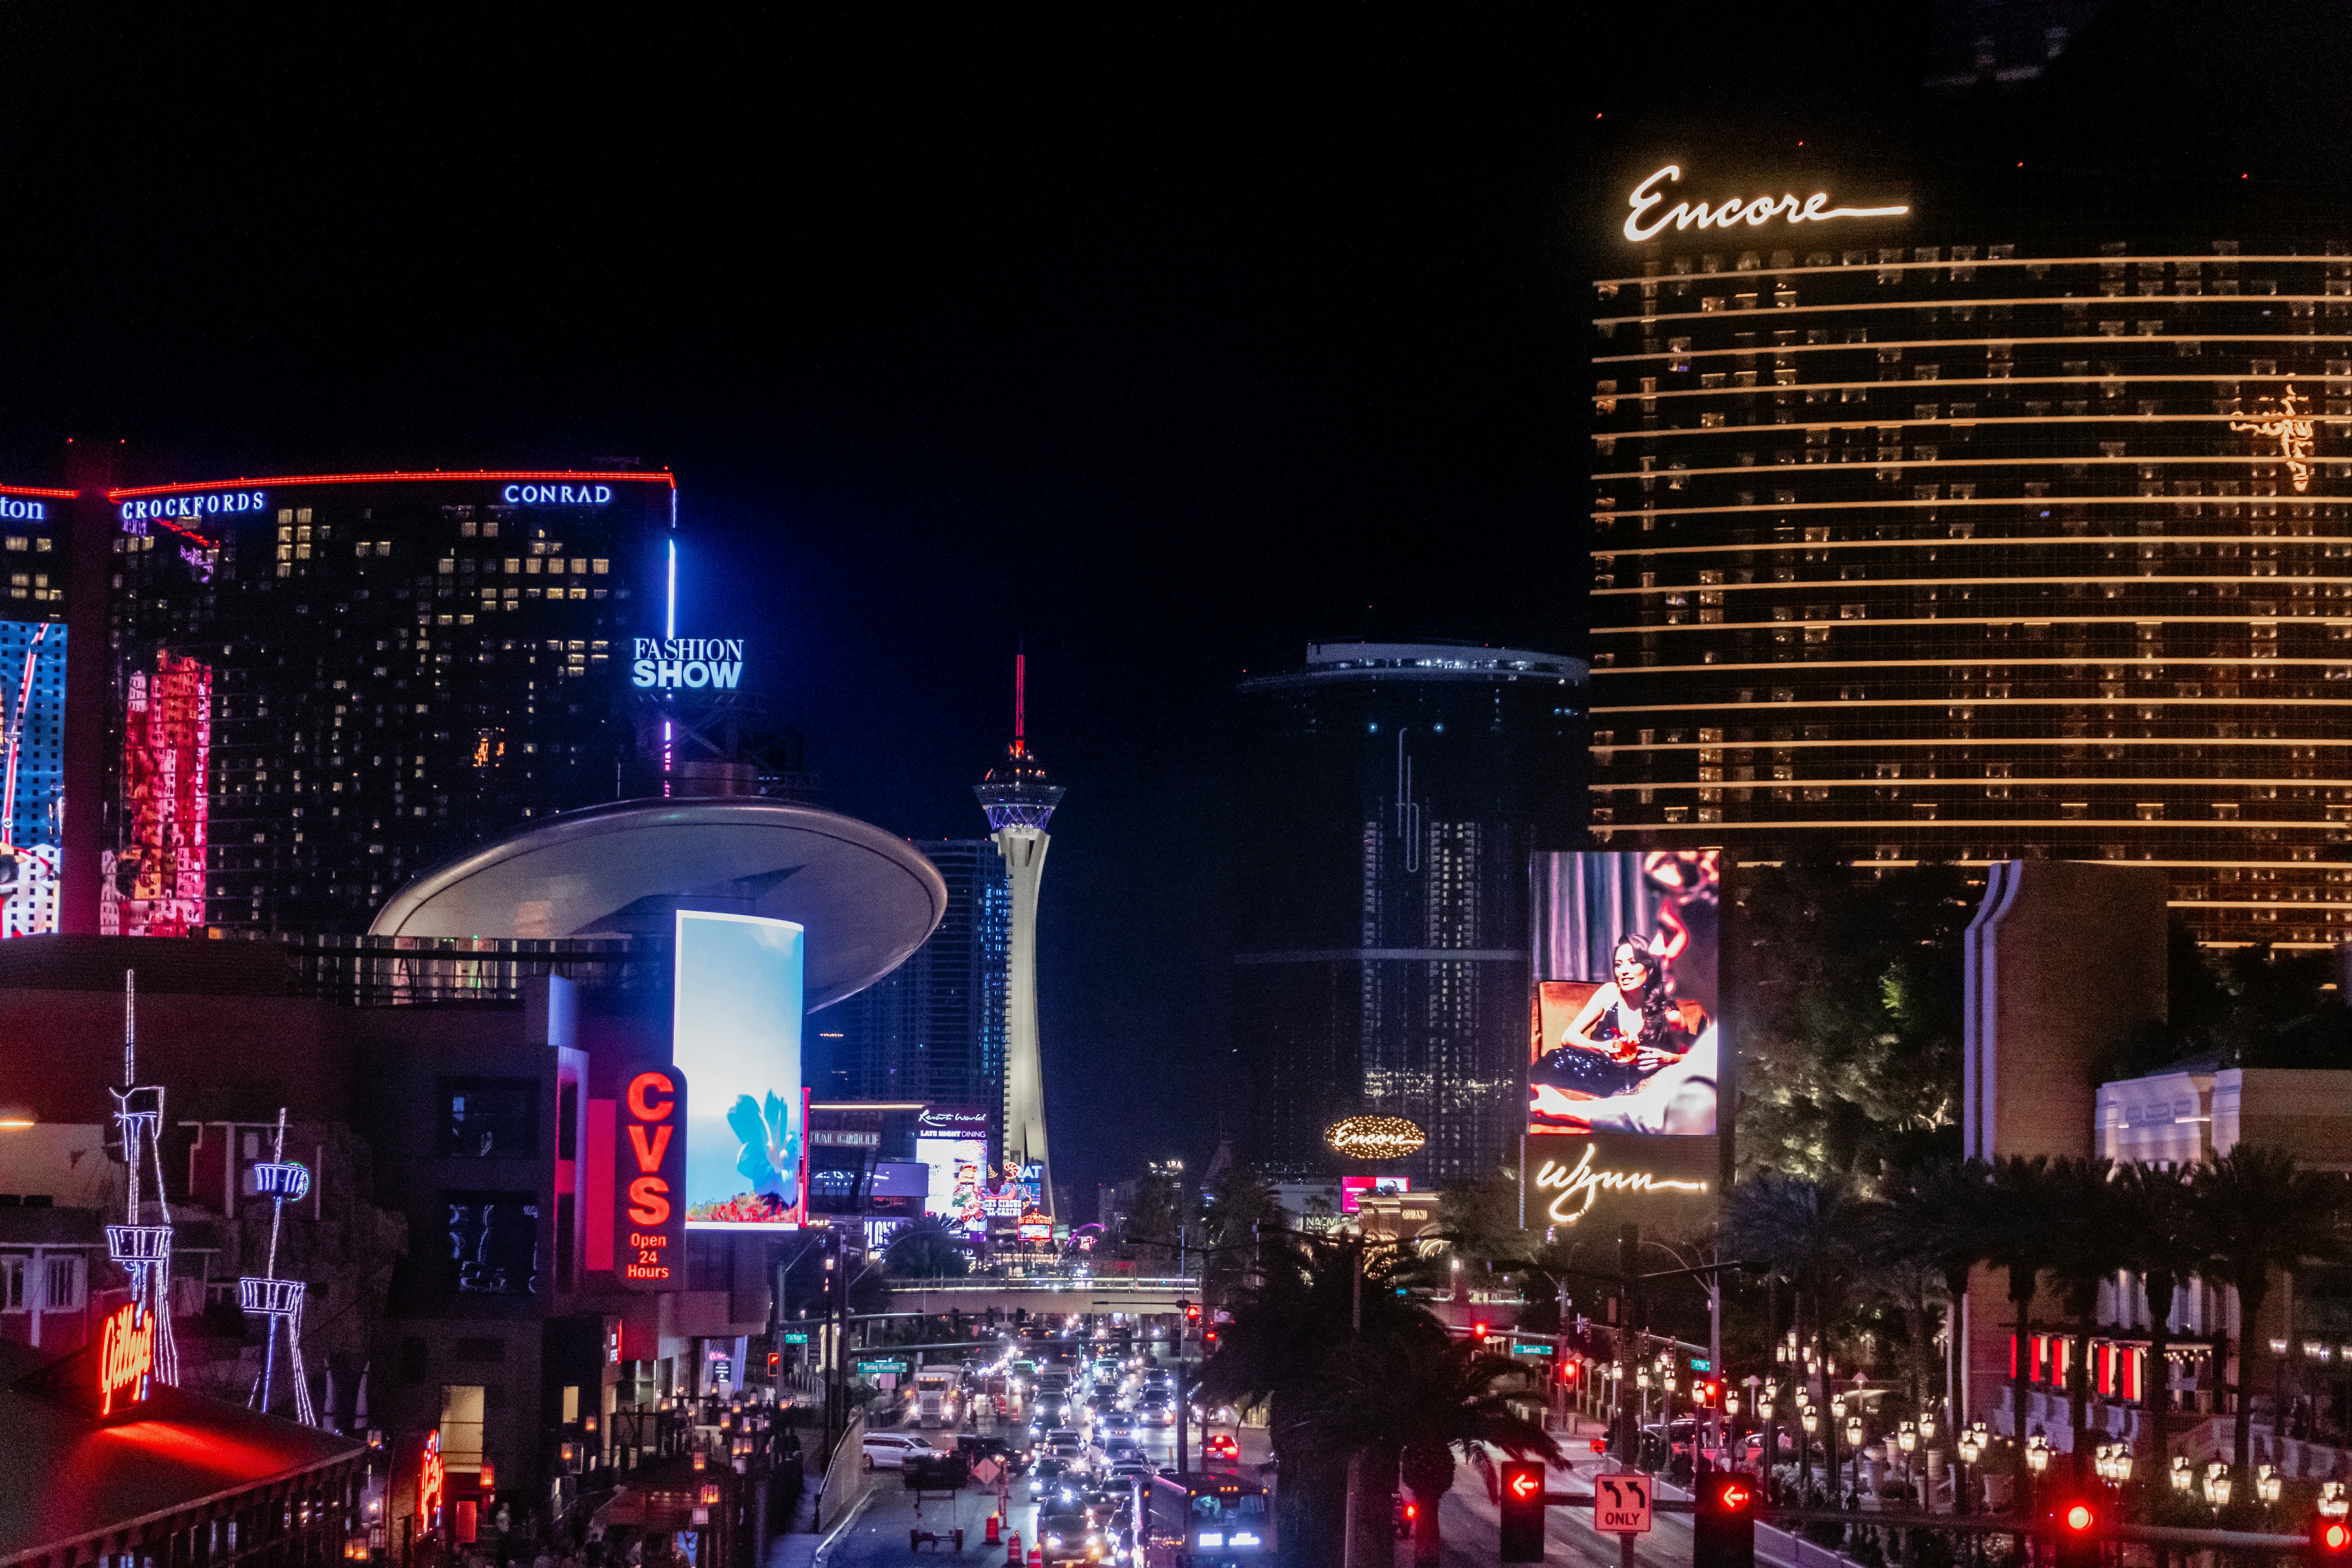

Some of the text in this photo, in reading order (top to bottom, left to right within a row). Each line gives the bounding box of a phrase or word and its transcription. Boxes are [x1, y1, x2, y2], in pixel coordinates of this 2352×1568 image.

[1624, 165, 1909, 242] Encore
[505, 485, 610, 503] CONRAD
[0, 497, 44, 519] ton
[122, 492, 264, 519] CROCKFORDS
[634, 638, 744, 661] FASHION
[633, 661, 742, 688] SHOW
[918, 1109, 953, 1127] Resorts
[837, 1134, 878, 1145] GRILLE
[1334, 1123, 1425, 1146] Encore
[628, 1072, 674, 1226] CVS
[1537, 1143, 1707, 1222] Wynn
[630, 1233, 666, 1249] Open
[639, 1250, 657, 1263] 24
[628, 1264, 669, 1278] Hours
[102, 1303, 152, 1414] Gilley's
[864, 1363, 878, 1372] Spring
[1606, 1512, 1639, 1525] ONLY
